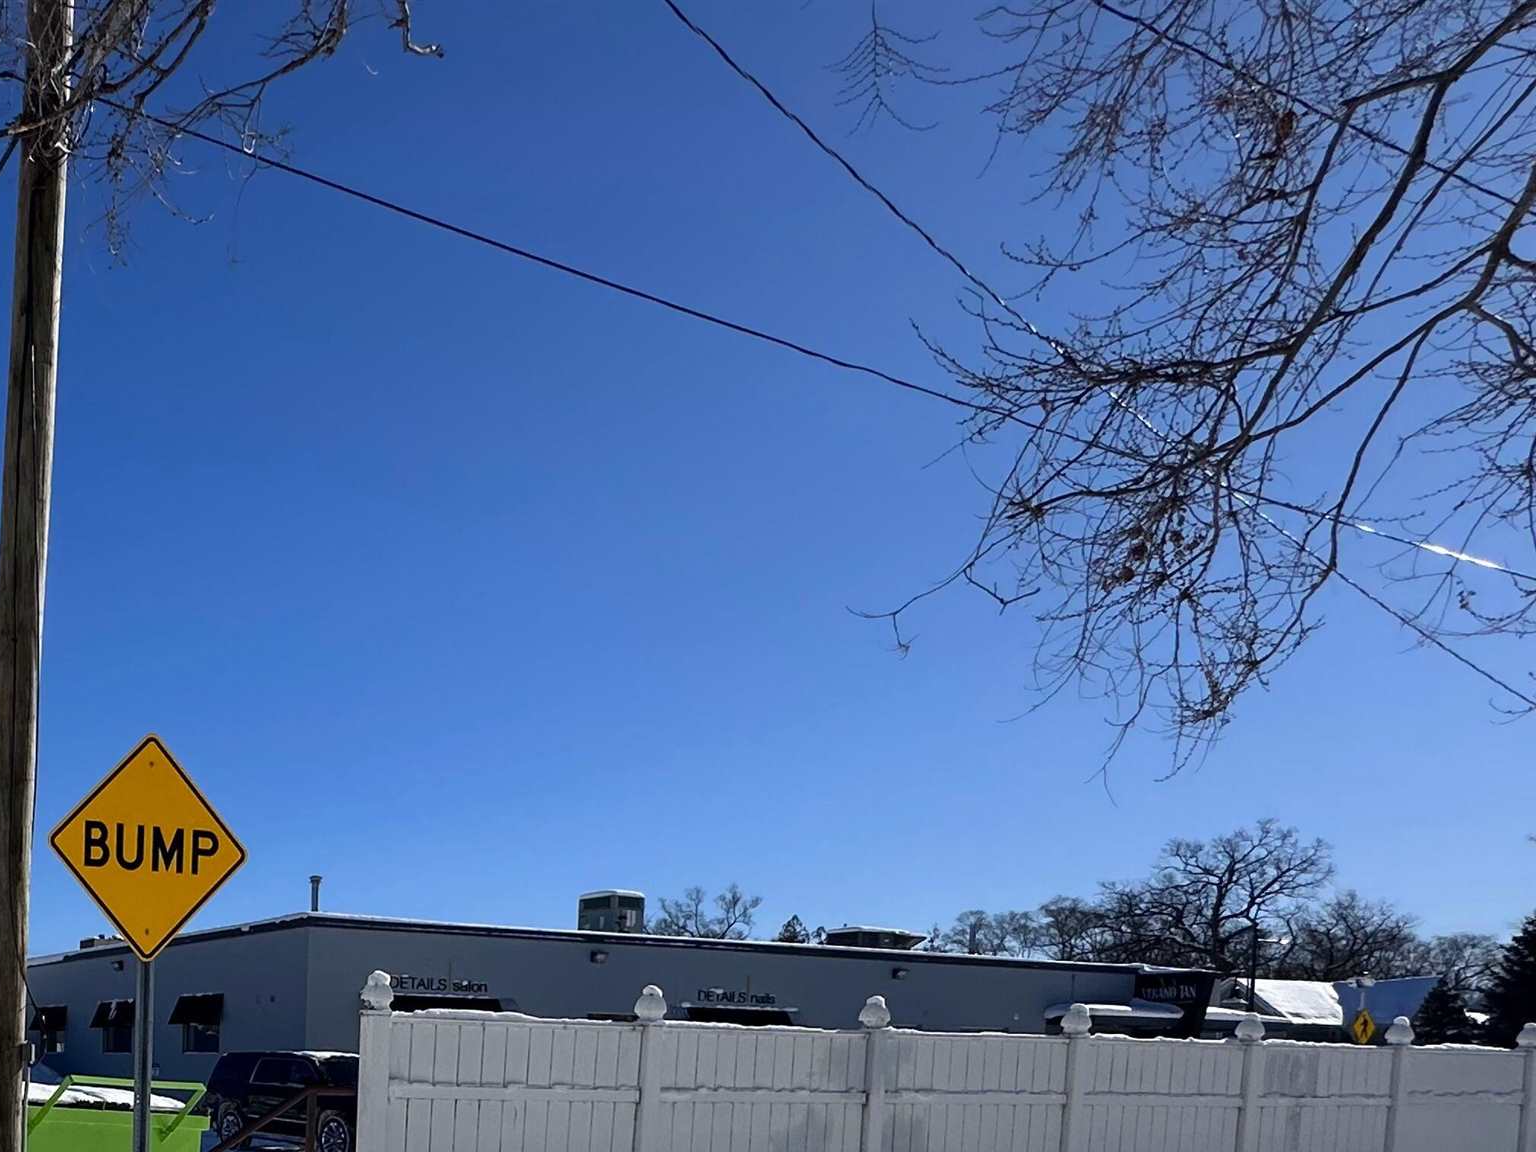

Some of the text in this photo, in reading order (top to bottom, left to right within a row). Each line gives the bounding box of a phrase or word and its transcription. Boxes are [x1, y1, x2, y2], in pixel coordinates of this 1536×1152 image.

[83, 819, 220, 876] BUMP
[390, 975, 488, 993] DETAILS salon
